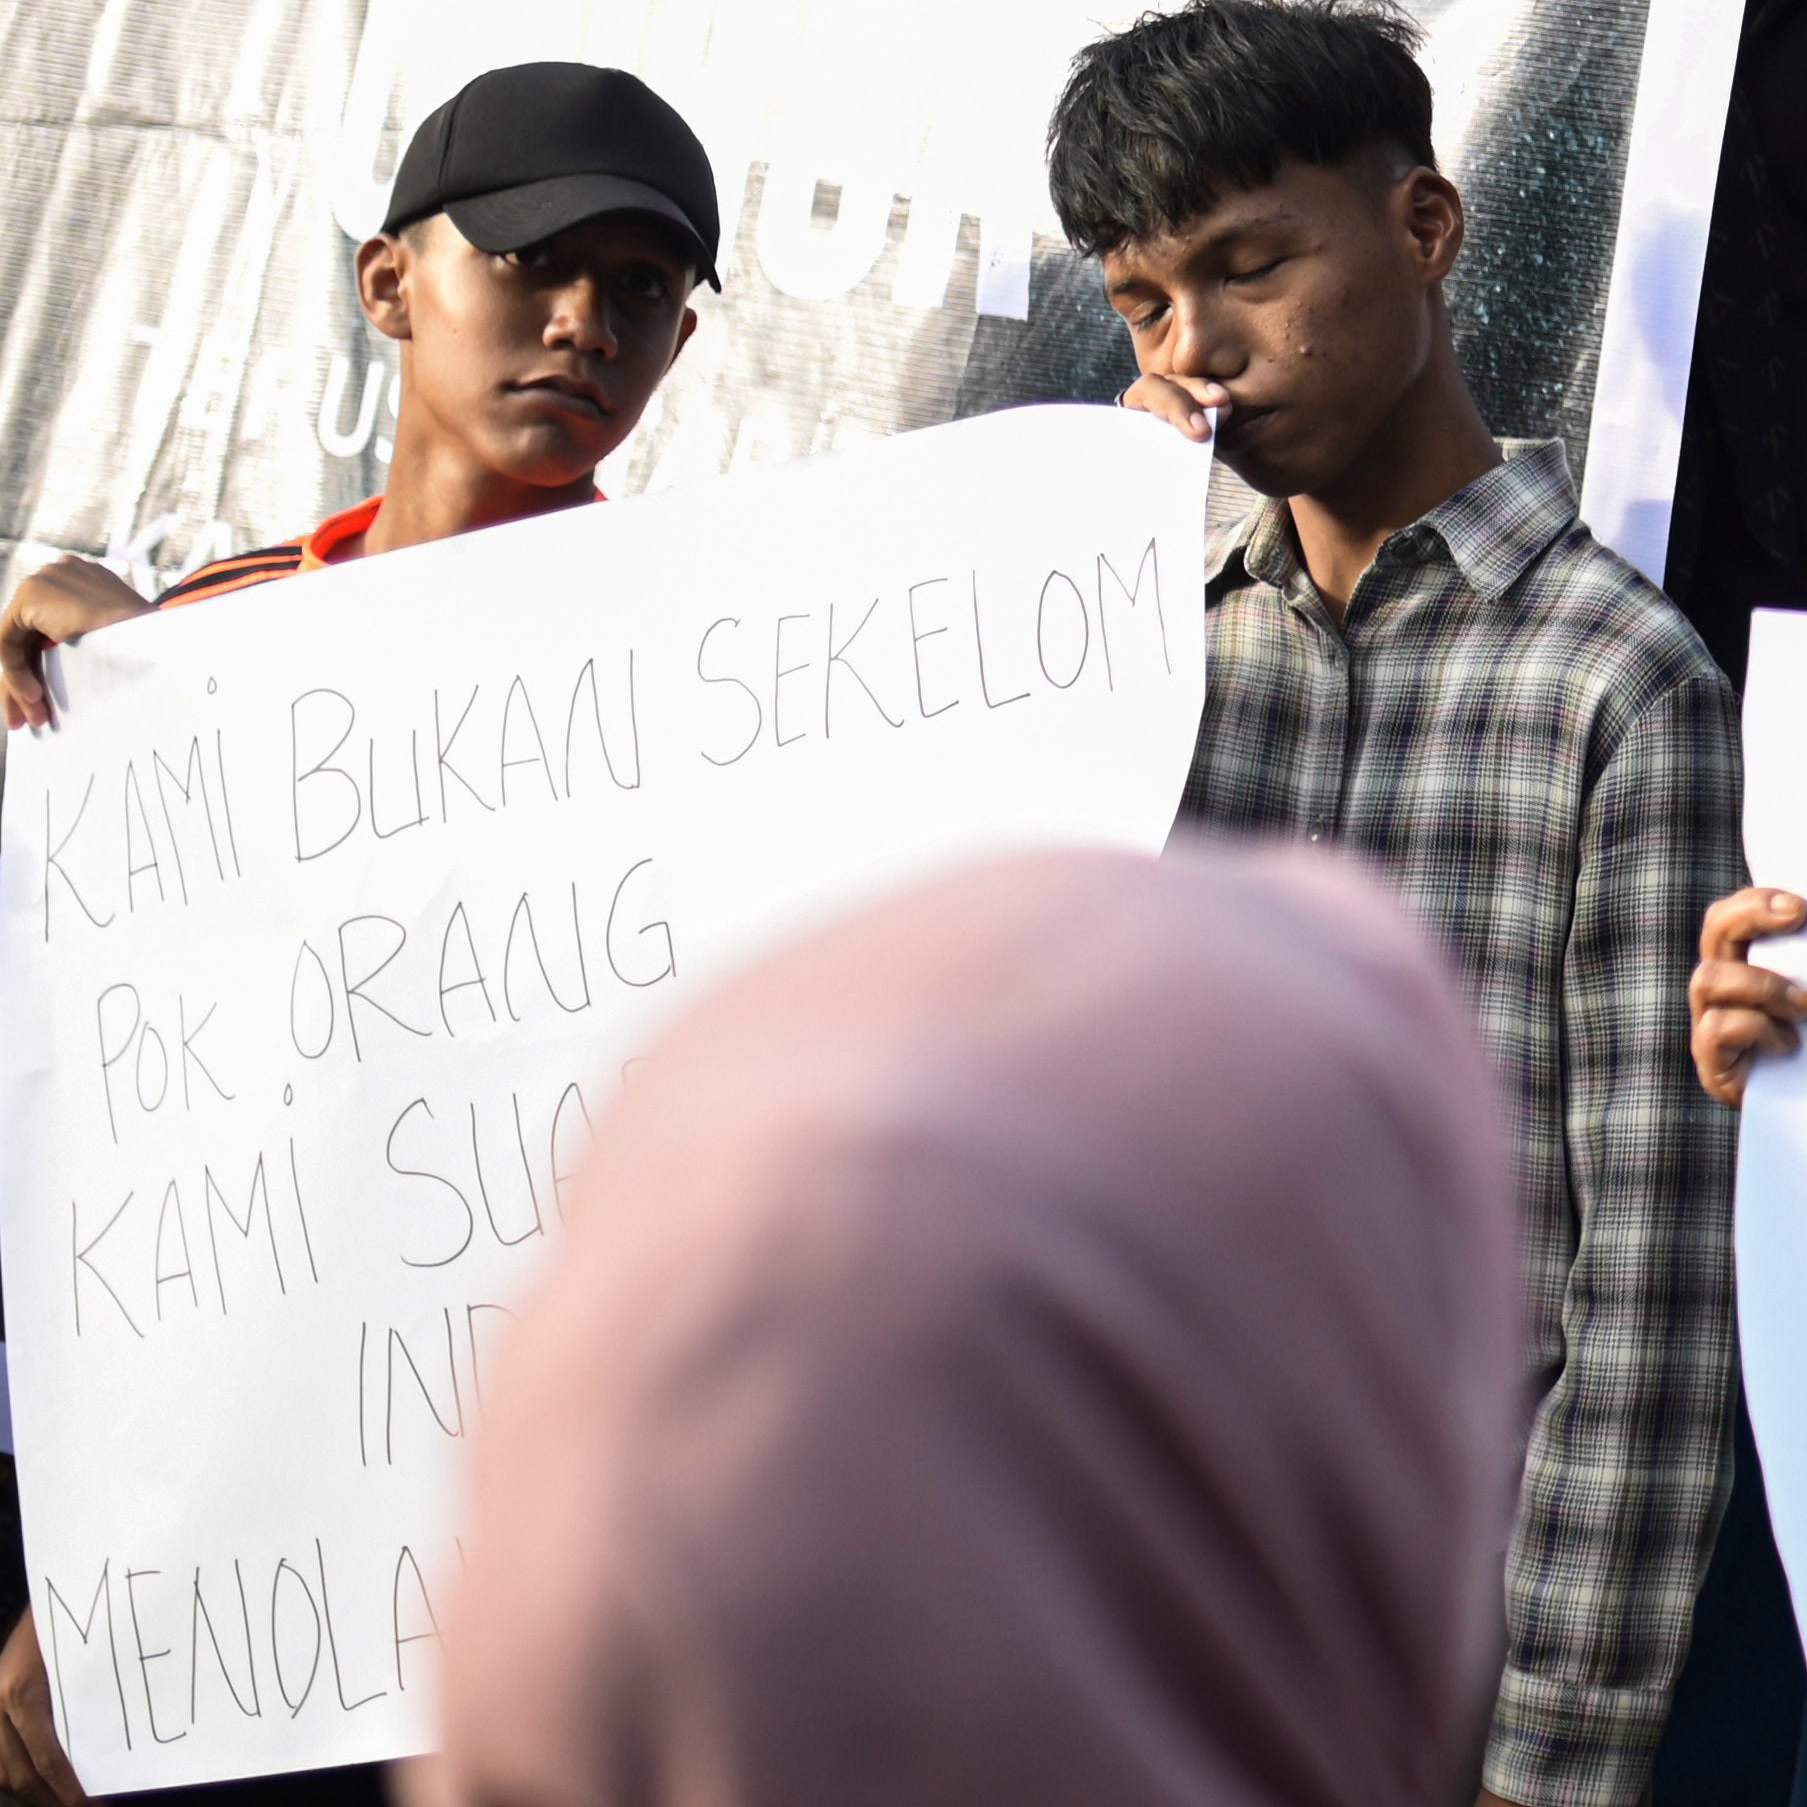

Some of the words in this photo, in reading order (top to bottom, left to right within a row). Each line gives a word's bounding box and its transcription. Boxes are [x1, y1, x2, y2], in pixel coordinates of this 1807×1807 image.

[290, 649, 641, 862] BUKAN
[697, 537, 1172, 766] SEKELOM
[97, 983, 236, 1145] POK
[290, 858, 676, 1063] ORANG
[44, 1535, 470, 1759] MENOLA
